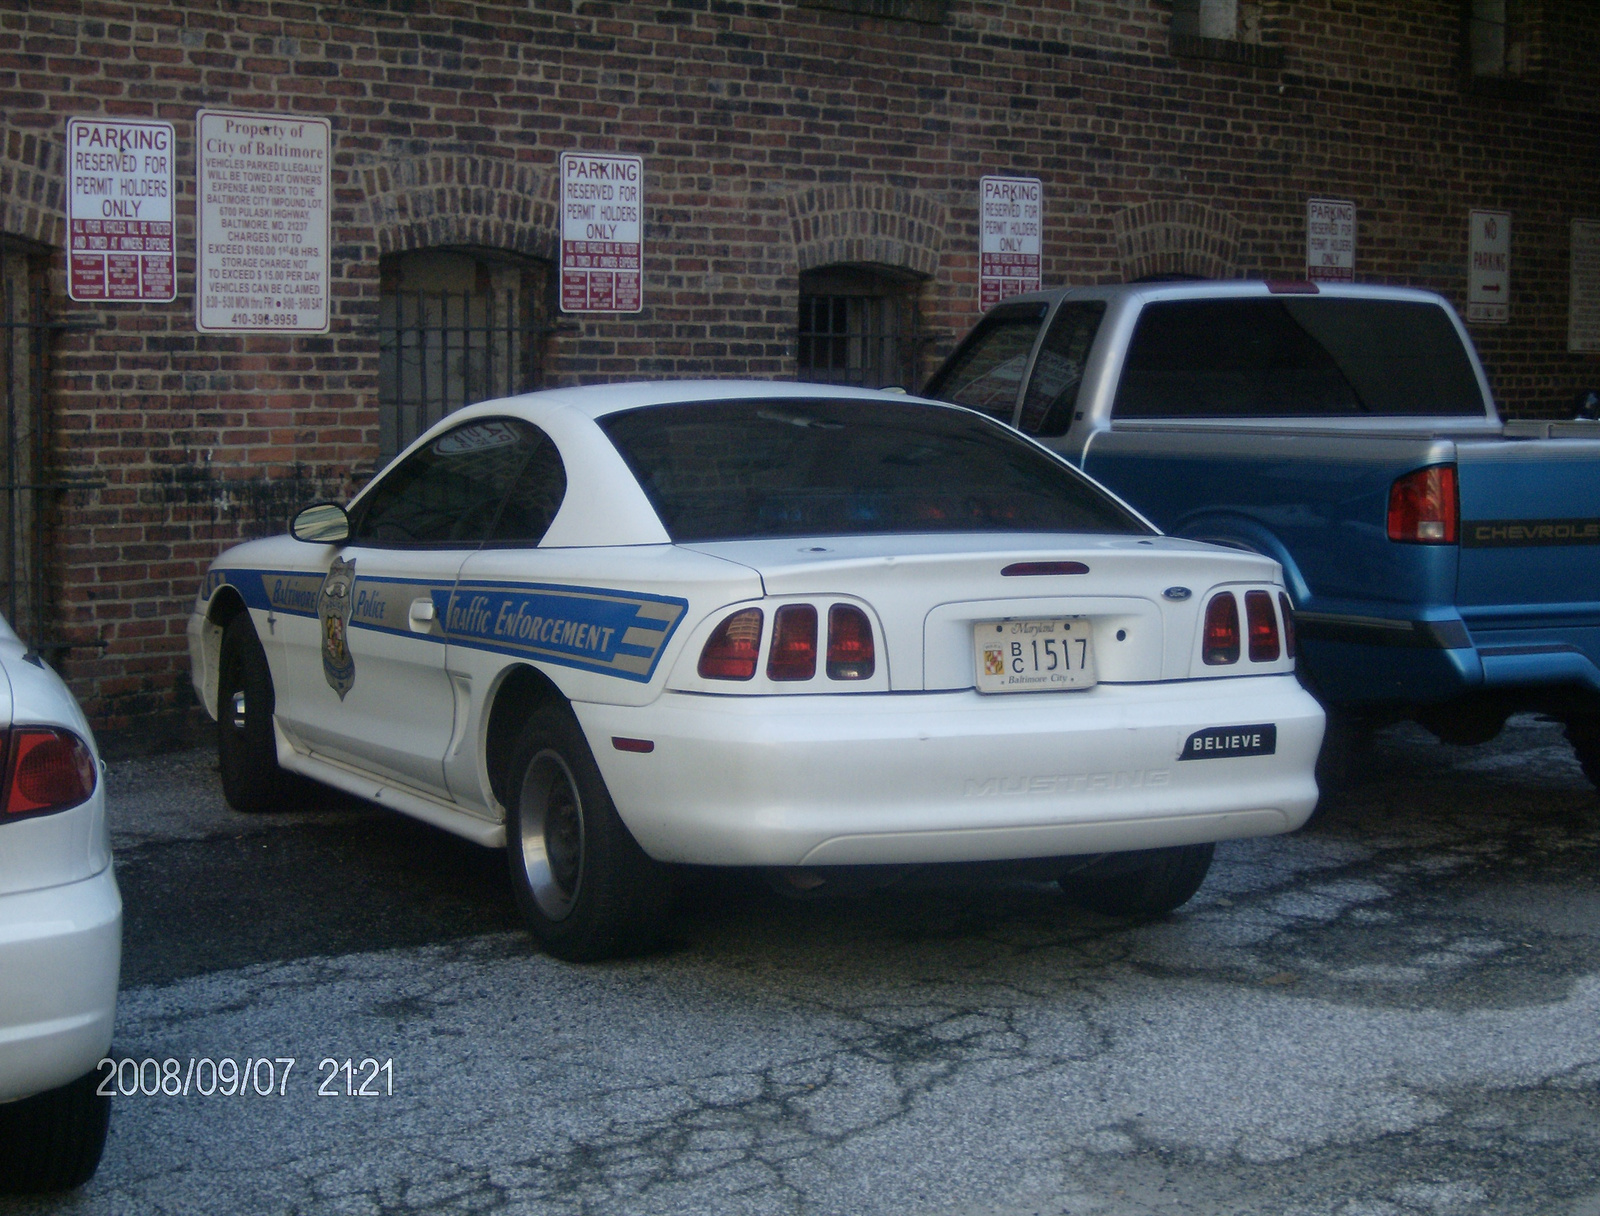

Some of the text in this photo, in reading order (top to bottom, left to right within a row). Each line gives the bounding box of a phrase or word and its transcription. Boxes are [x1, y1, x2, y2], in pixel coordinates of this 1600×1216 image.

[76, 126, 167, 150] PARKING
[225, 120, 305, 140] Property of
[206, 138, 324, 159] City of Baltimore
[76, 152, 167, 174] RESERVED FOR
[205, 158, 324, 174] VEHICLES PARKED ILLEGALLY
[567, 160, 637, 181] PARKING
[207, 170, 322, 186] WILL BE TOWED AT OWNERS
[76, 176, 167, 198] PERMIT HOLDERS
[212, 182, 315, 197] EXPENSE AND RISK TO THE
[567, 183, 637, 202] RESERVED FOR
[985, 183, 1038, 201] PARKING
[102, 200, 142, 218] ONLY
[207, 194, 251, 205] BALTIMORE
[252, 196, 270, 206] CITY
[271, 197, 306, 208] IMPOUND
[238, 207, 272, 218] PULASKI
[567, 203, 636, 222] PERMIT HOLDERS
[985, 203, 1037, 218] RESERVED FOR
[1311, 205, 1352, 221] PARKING
[586, 223, 617, 240] ONLY
[985, 220, 1007, 235] PERMIT
[228, 231, 302, 244] CHARGES NOT TO
[1000, 238, 1023, 252] ONLY
[208, 243, 244, 255] EXCEED
[221, 257, 308, 270] STORAGE CHARGE NOT
[208, 268, 220, 278] TO
[222, 269, 255, 280] EXCEED
[286, 271, 303, 281] PER
[304, 271, 320, 281] DAY
[209, 282, 320, 295] VEHICLES CAN BE CLAIMED
[1010, 622, 1055, 637] Maryland
[1031, 639, 1087, 672] 1517
[1008, 673, 1068, 684] Baltimore City
[1193, 734, 1261, 751] BELIEVE
[963, 768, 1171, 798] MUSTANG
